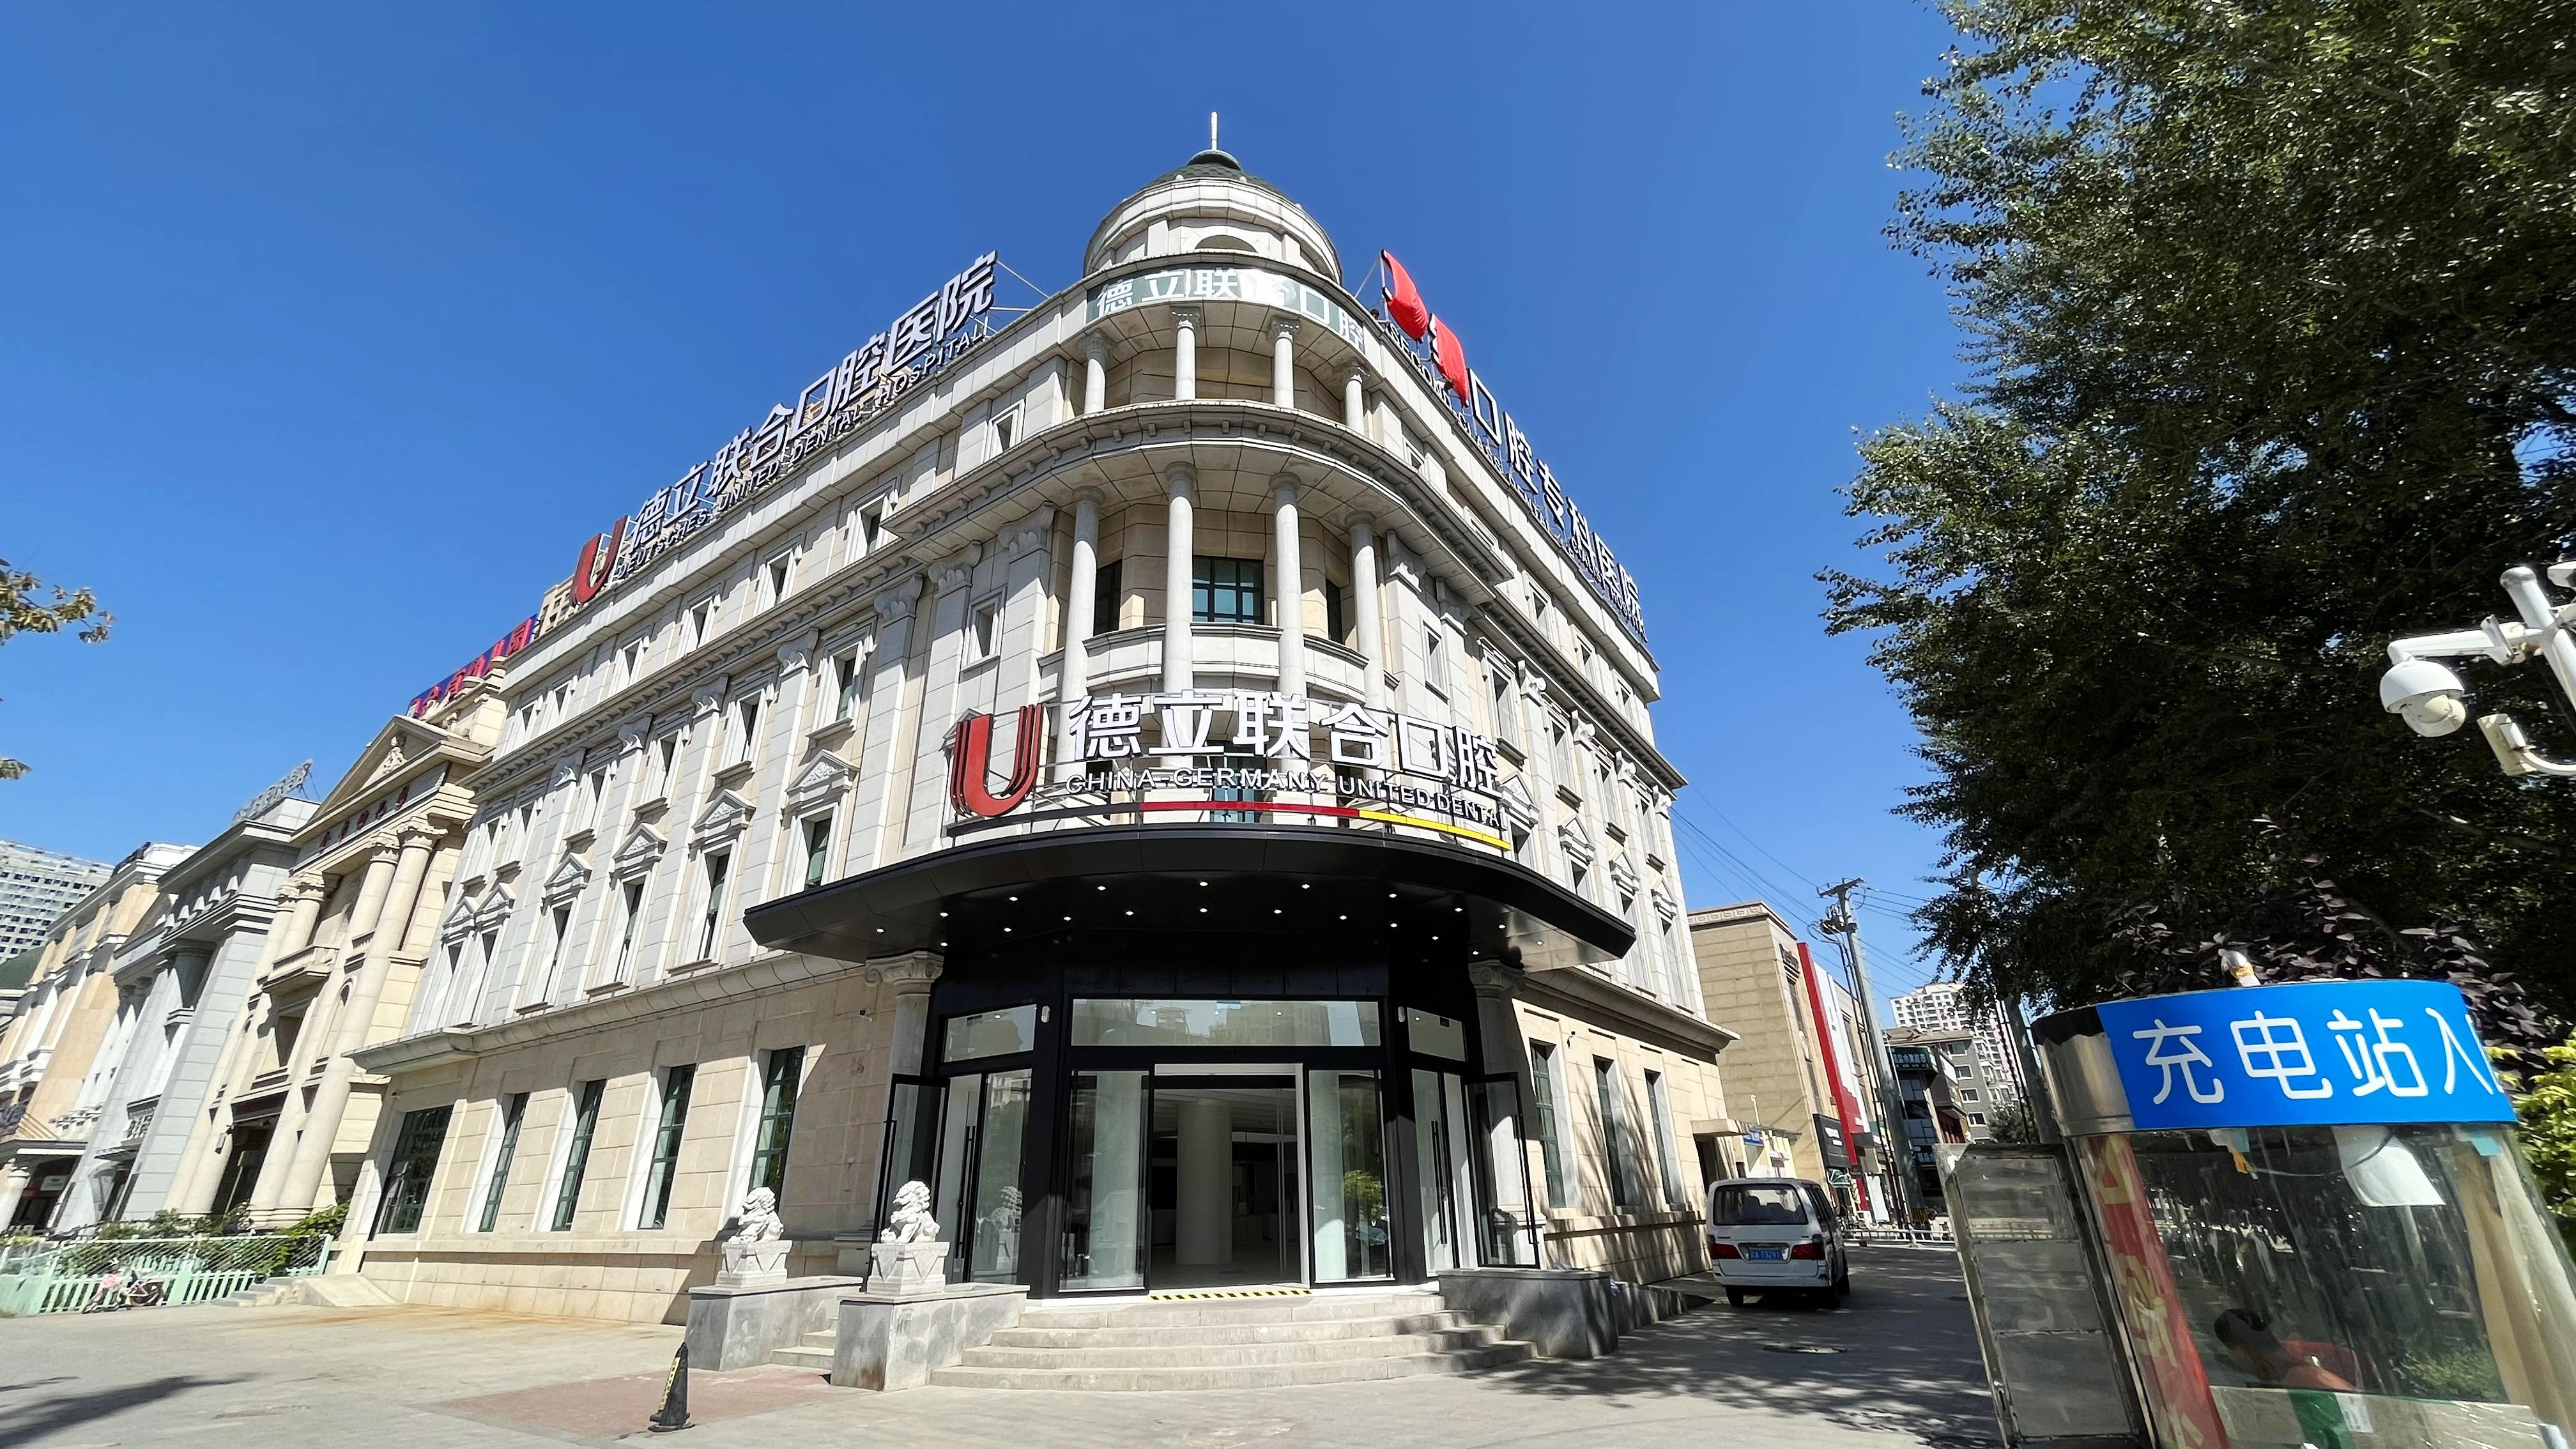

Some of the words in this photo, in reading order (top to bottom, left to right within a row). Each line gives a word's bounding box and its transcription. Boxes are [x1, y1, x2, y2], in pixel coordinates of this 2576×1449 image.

[629, 249, 998, 553] 德立联合口腔医院
[788, 405, 862, 463] DENTAL
[877, 324, 985, 405] HOSPITAL
[1069, 689, 1503, 798] 德立联合口腔
[1339, 775, 1431, 808] UNITED
[1437, 792, 1510, 831] DENTAL
[2133, 1007, 2504, 1105] 充电站入
